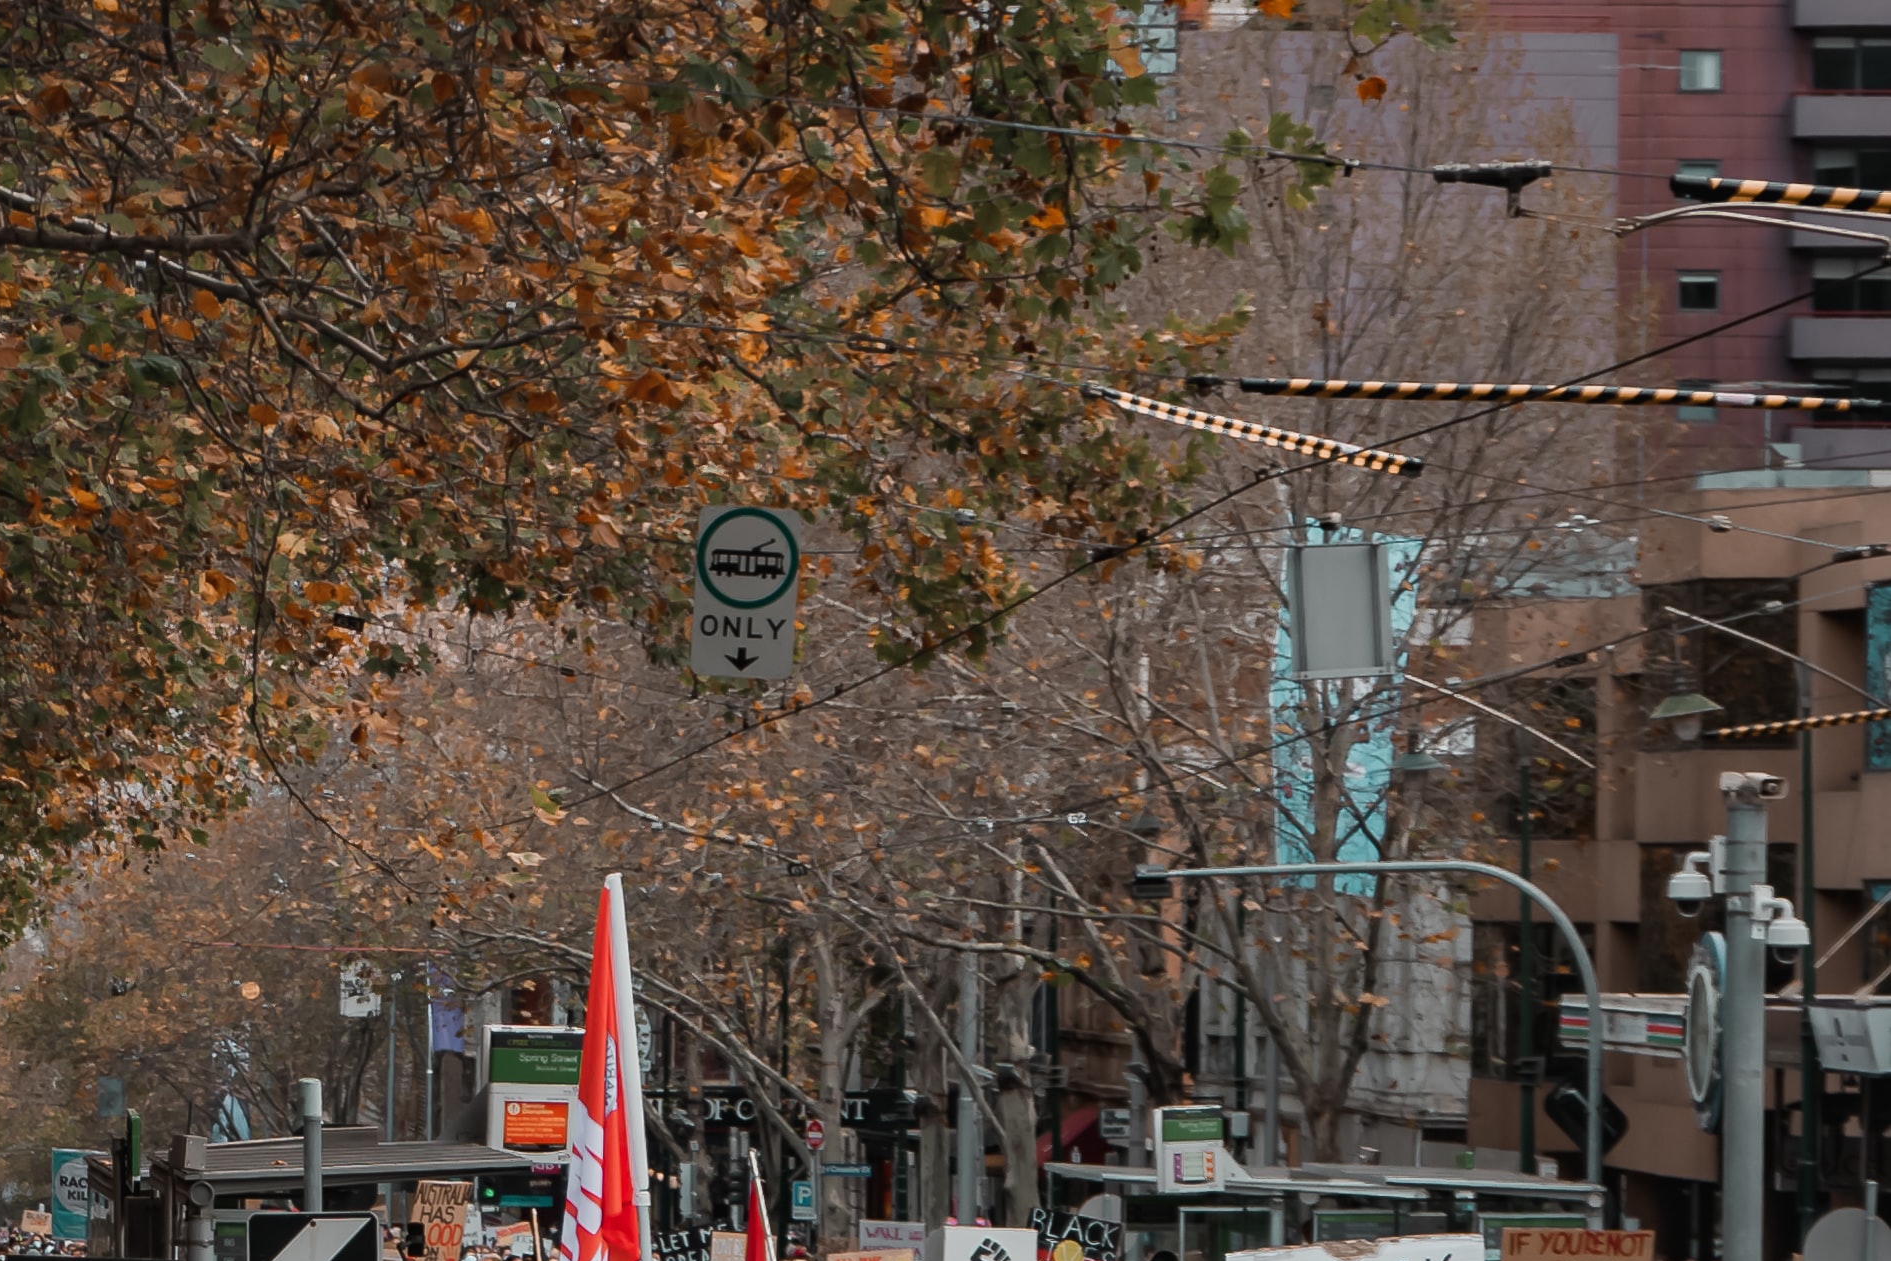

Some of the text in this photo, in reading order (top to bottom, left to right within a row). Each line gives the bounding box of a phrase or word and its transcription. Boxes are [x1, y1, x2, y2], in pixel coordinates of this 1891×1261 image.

[699, 613, 789, 642] ONLY
[59, 1175, 88, 1189] RAC
[420, 1205, 456, 1224] HAS
[1030, 1207, 1121, 1249] BLACK
[659, 1231, 692, 1254] LET
[1509, 1232, 1653, 1257] IF NOT
